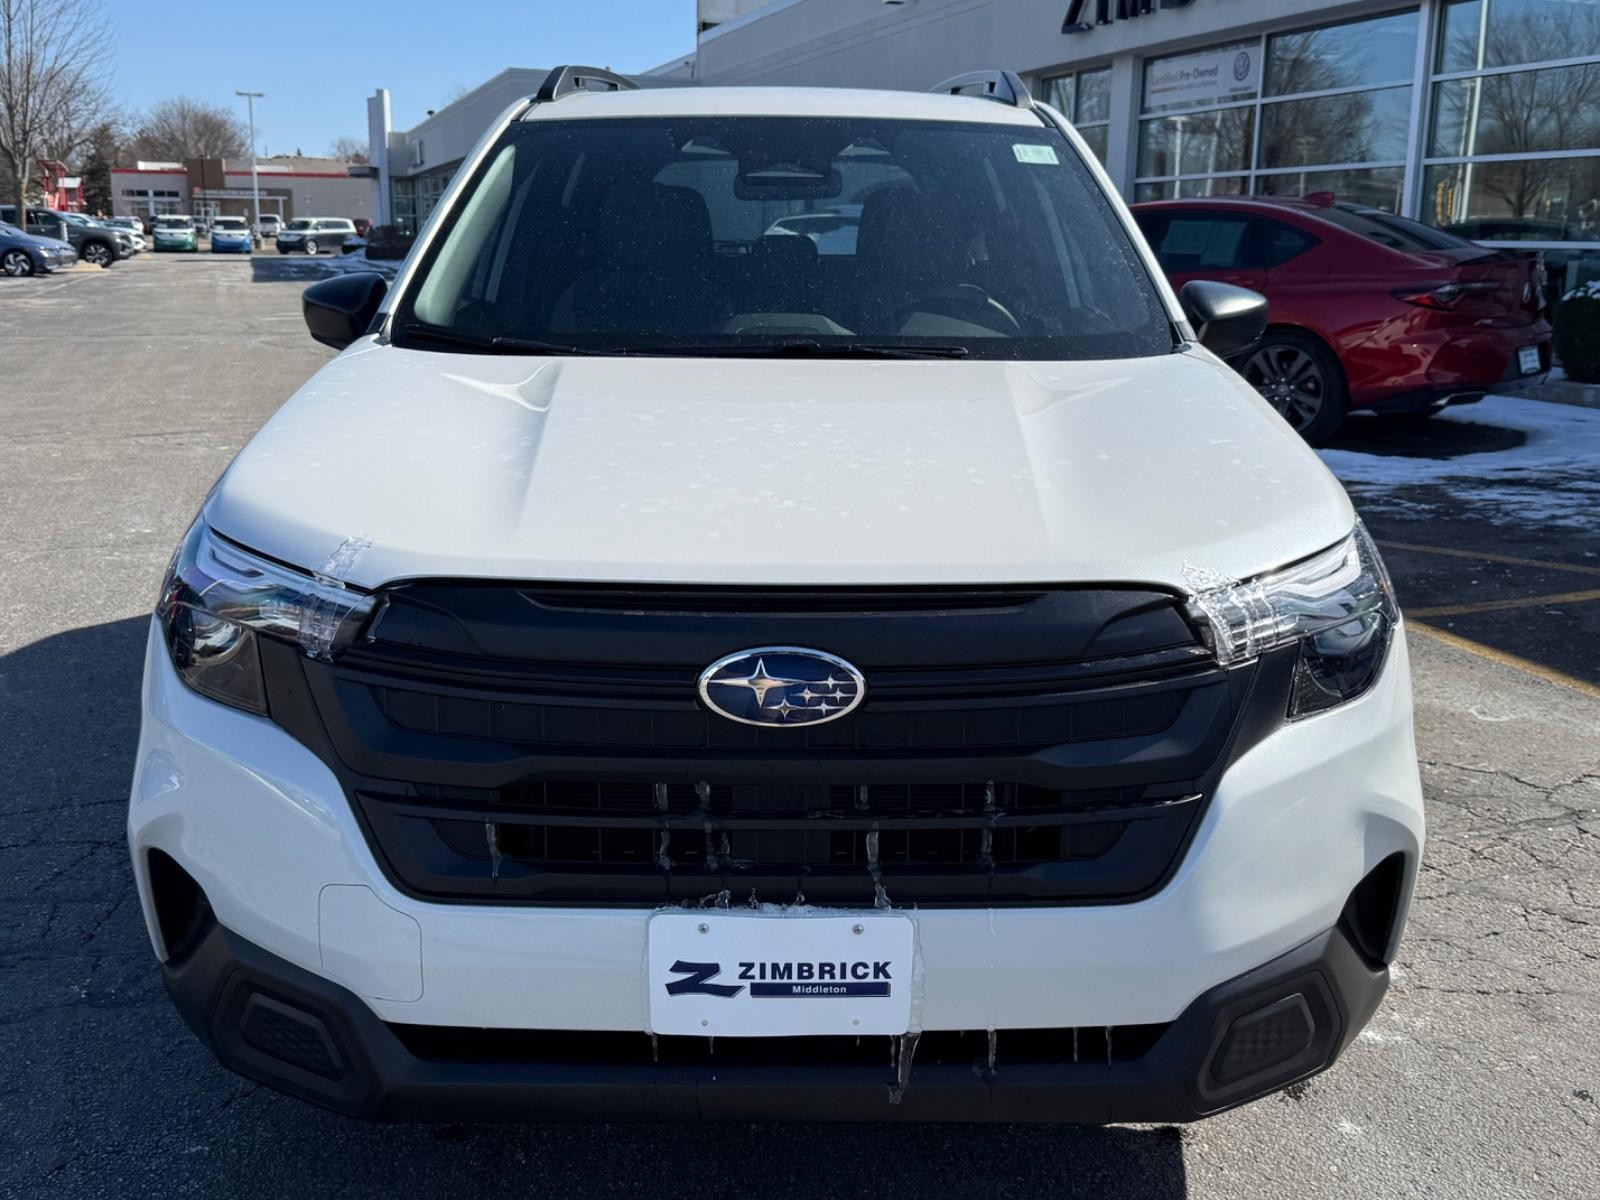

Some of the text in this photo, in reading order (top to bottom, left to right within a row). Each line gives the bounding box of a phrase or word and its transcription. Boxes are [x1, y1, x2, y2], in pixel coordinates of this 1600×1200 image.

[1179, 64, 1219, 80] Pre-Owned
[738, 961, 892, 980] ZIMBRICK
[792, 985, 847, 994] Middleton
